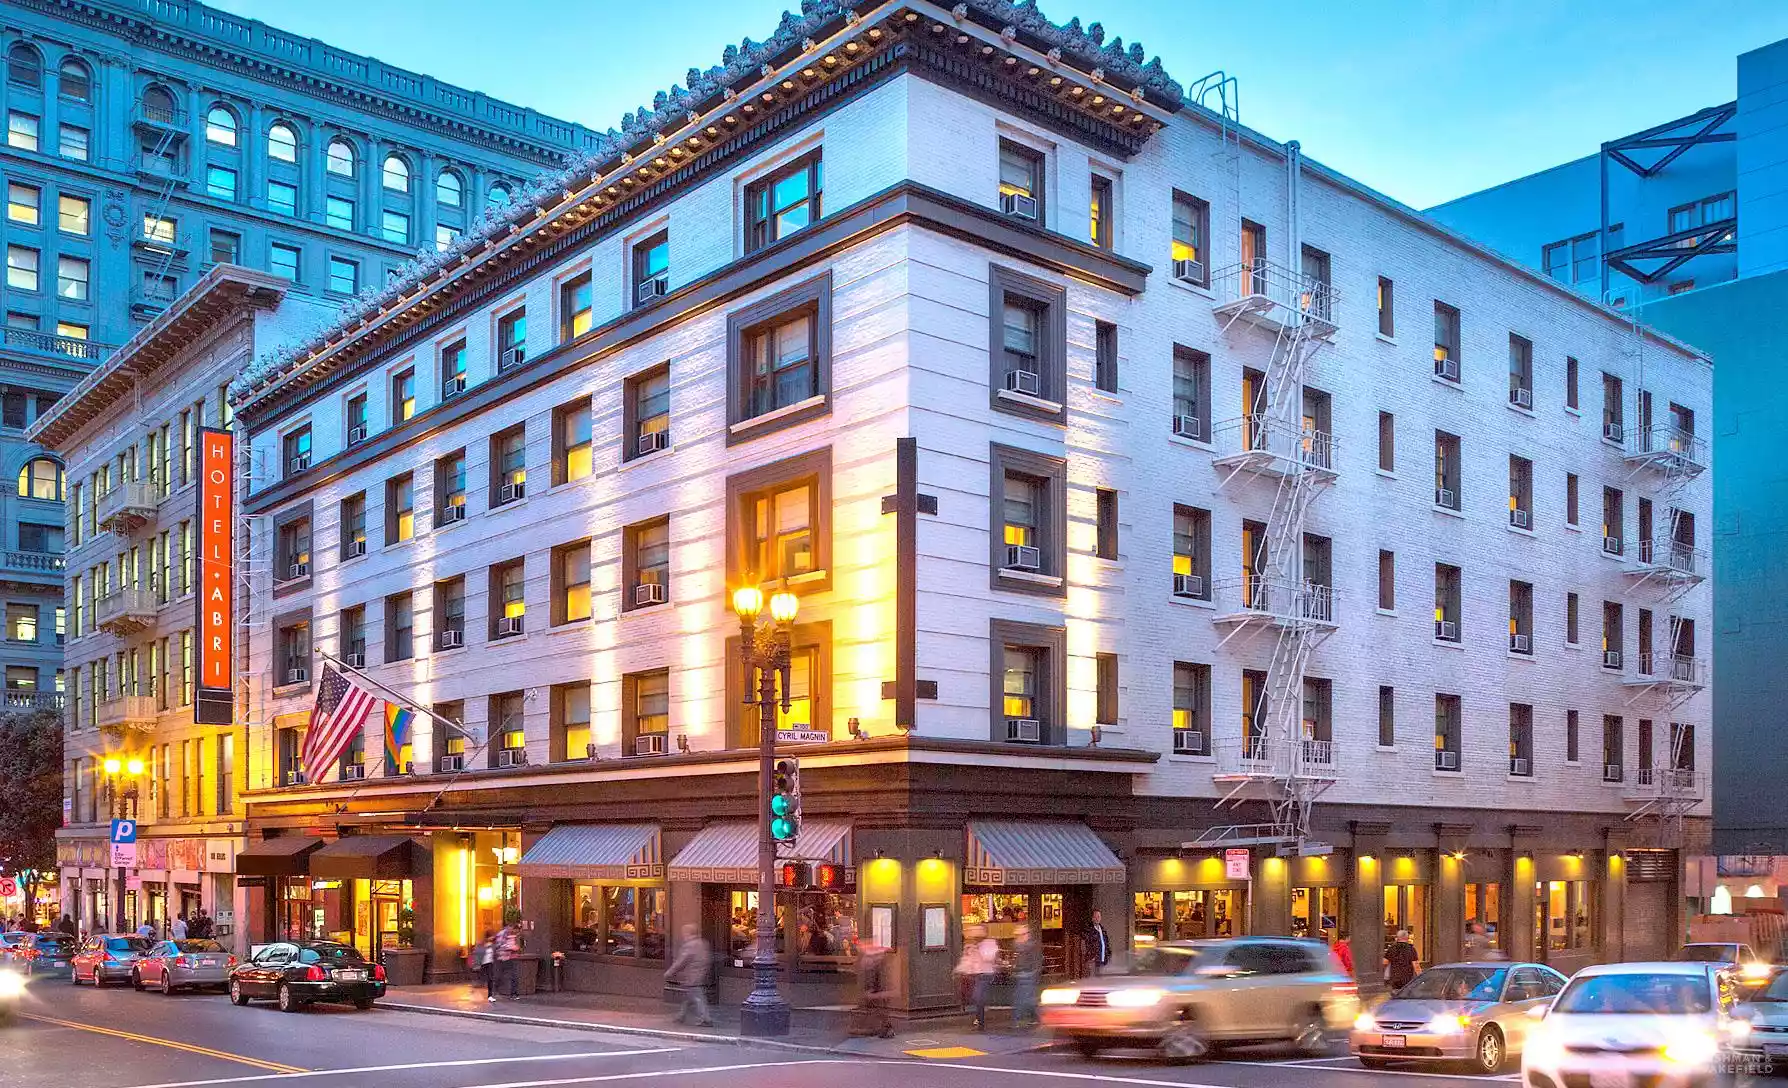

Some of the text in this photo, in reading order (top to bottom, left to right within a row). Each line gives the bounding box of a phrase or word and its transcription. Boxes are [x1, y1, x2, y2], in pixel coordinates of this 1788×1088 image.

[211, 444, 225, 676] HOTEL ABRI
[778, 732, 826, 741] CYRIL MAGNIN
